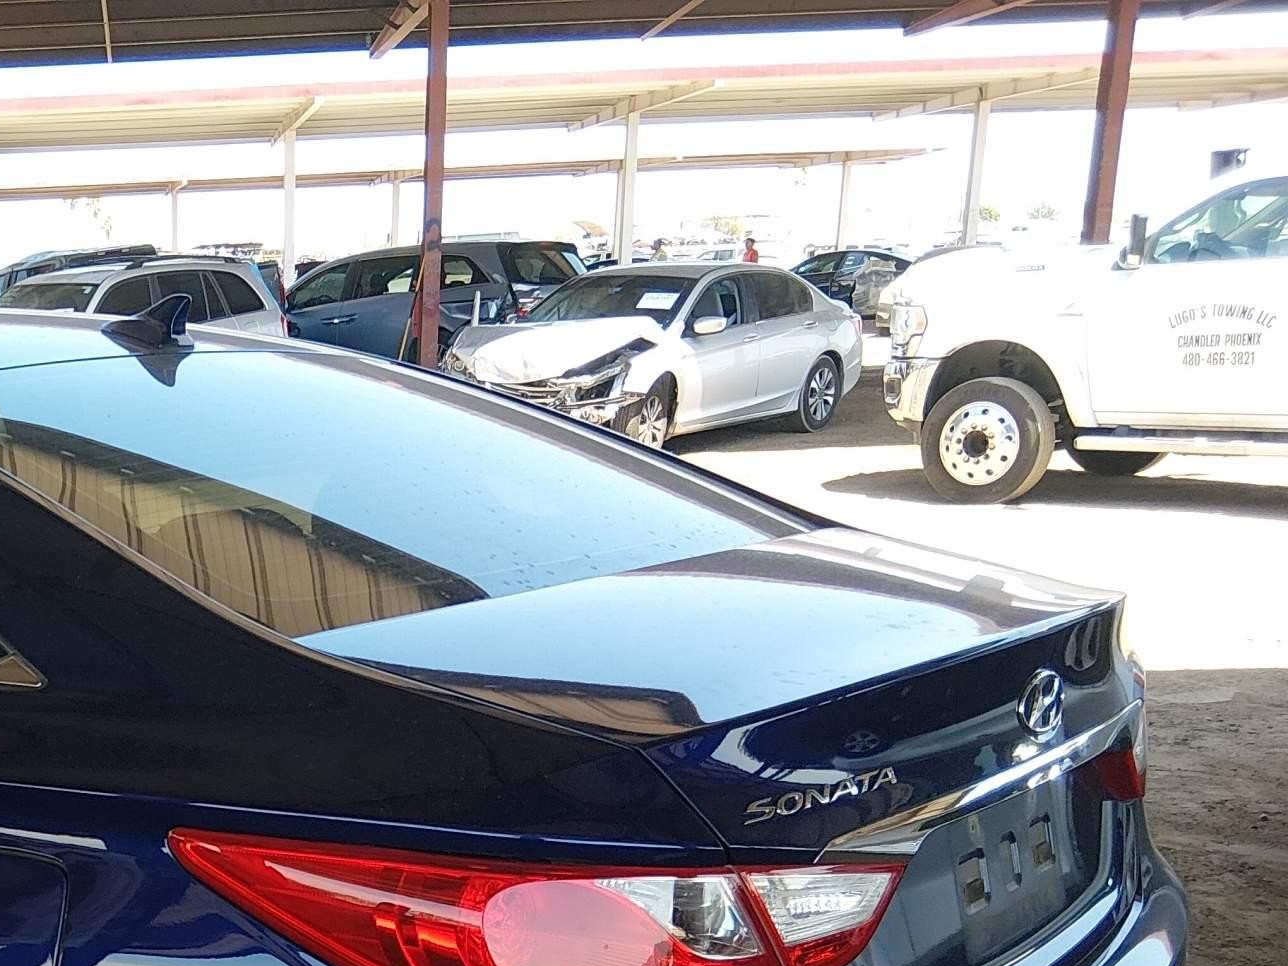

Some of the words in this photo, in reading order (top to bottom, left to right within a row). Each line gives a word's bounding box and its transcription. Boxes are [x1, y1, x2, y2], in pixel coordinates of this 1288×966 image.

[1168, 305, 1207, 329] LUGO'S
[1212, 303, 1255, 320] TOWING
[1256, 310, 1277, 329] LLC
[1177, 334, 1221, 348] CHANDLER
[1224, 332, 1262, 346] PHOENIX
[1182, 351, 1255, 367] 480-466-3821
[743, 765, 898, 826] SONATA
